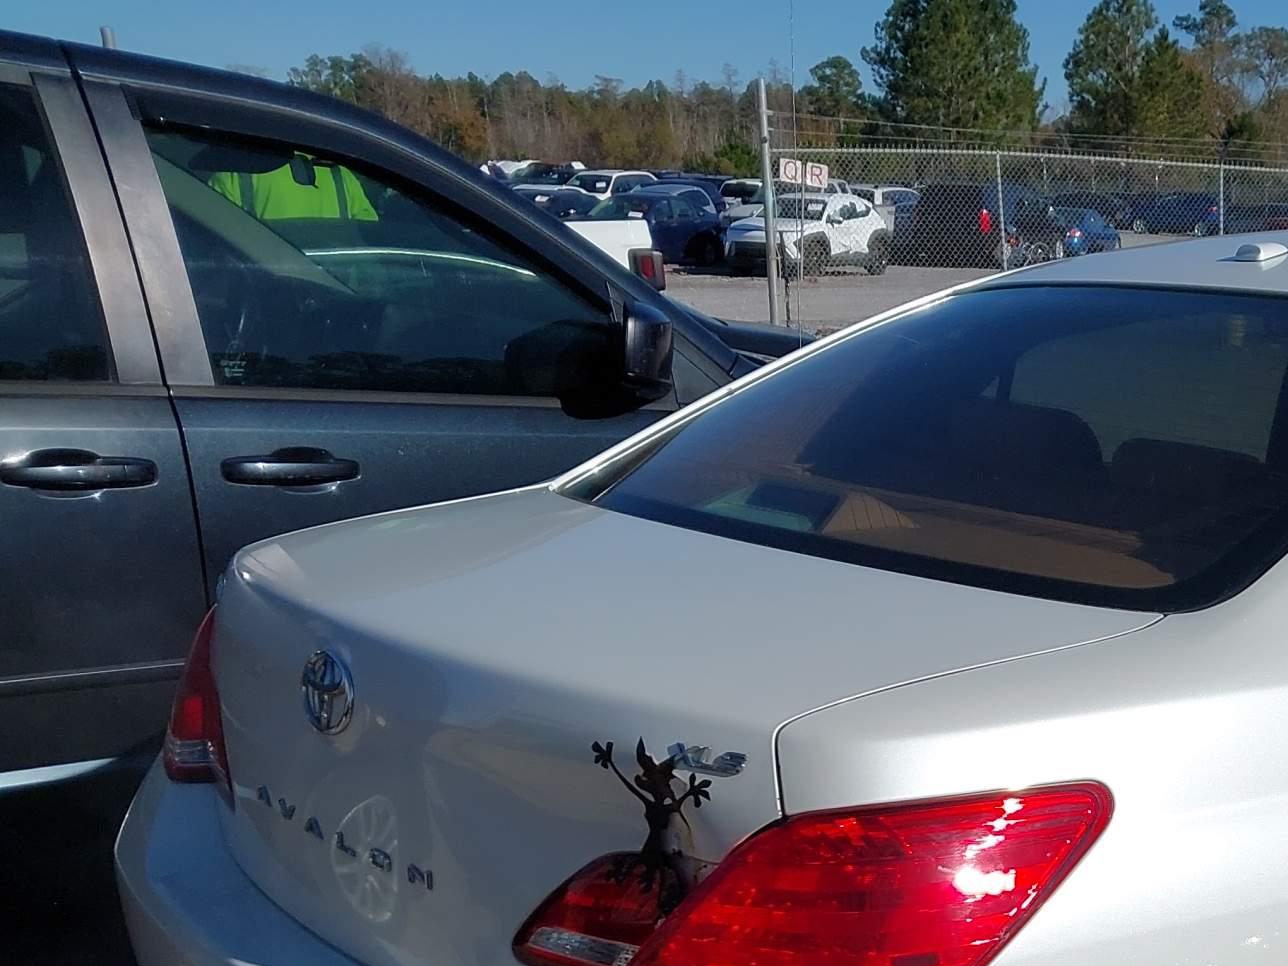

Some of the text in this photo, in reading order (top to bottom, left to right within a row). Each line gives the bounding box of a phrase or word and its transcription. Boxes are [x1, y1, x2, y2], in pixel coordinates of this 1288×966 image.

[783, 160, 798, 182] Q
[810, 164, 824, 186] R
[256, 784, 434, 890] AVALON
